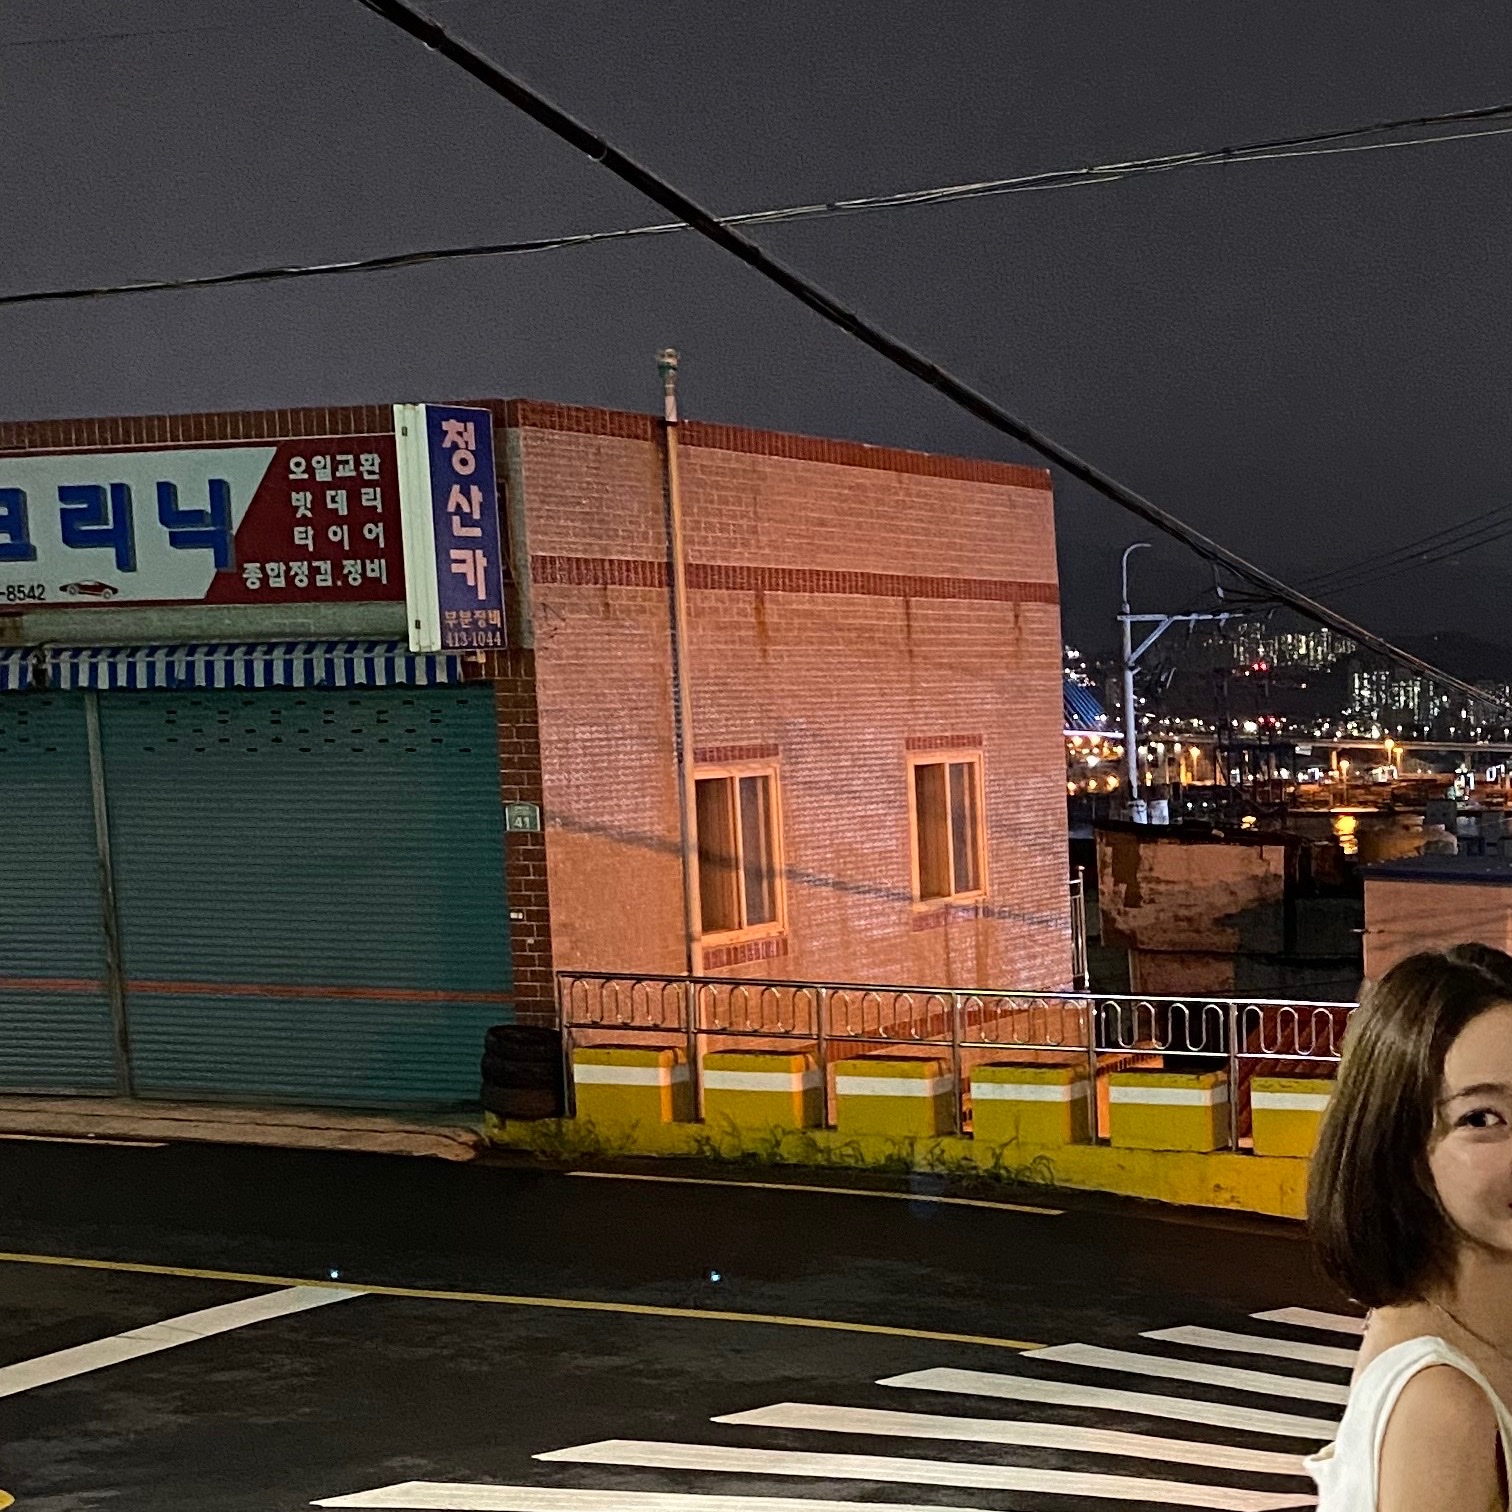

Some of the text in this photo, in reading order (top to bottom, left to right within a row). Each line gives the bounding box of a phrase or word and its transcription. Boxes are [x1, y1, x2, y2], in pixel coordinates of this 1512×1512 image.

[288, 453, 381, 482] 오일교환
[441, 419, 487, 600] 청산카
[293, 522, 385, 552] 타이어
[444, 609, 501, 629] 부분정비
